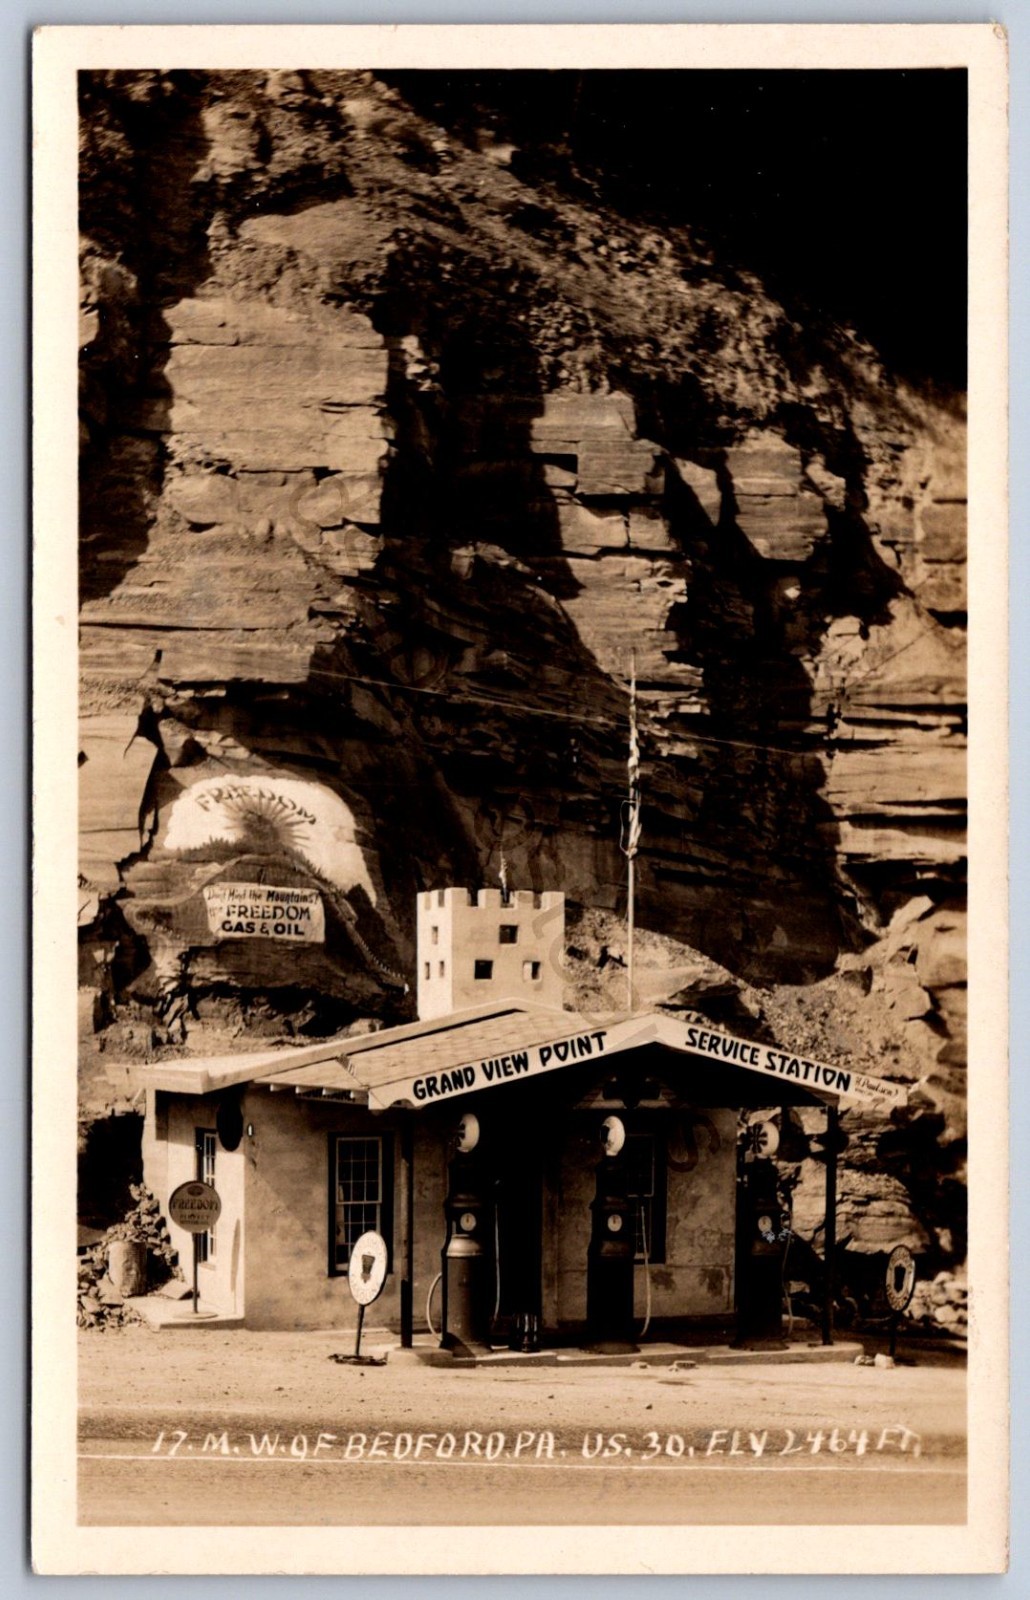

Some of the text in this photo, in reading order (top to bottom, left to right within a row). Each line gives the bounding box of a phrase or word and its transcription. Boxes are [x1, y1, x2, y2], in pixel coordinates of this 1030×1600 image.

[221, 920, 305, 935] GAS & OIL
[226, 905, 311, 920] FREEDOM
[413, 1031, 607, 1100] GRAND VIEW POINT
[685, 1028, 851, 1092] SERVICE STATION
